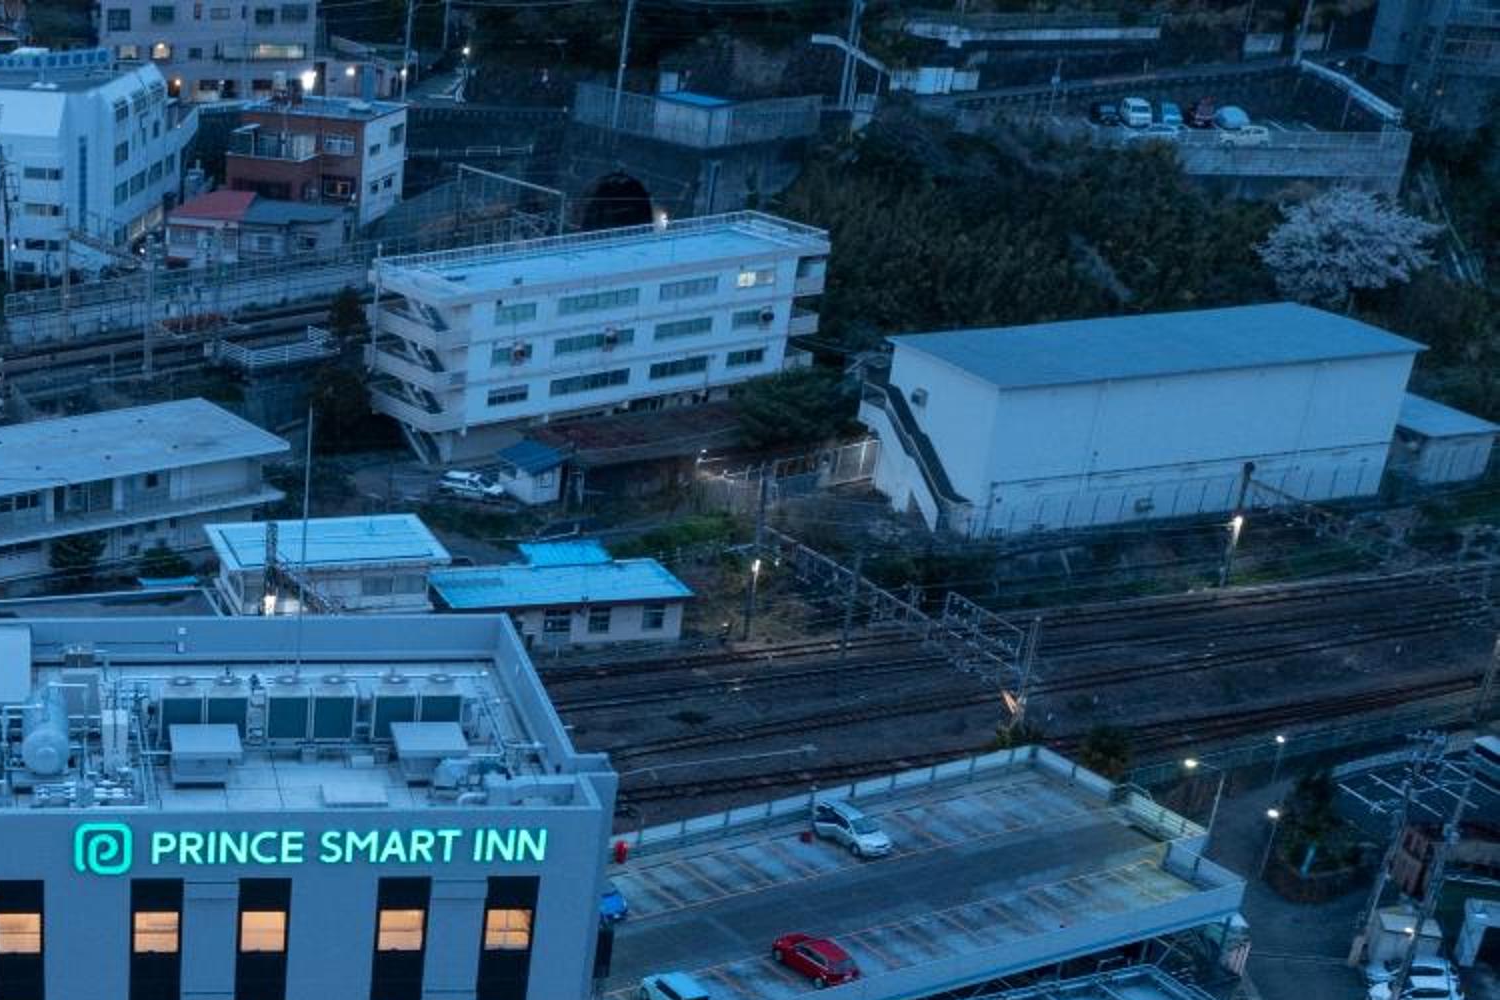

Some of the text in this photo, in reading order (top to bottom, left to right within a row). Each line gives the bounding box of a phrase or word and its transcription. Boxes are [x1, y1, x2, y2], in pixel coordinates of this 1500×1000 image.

[150, 831, 305, 865] PRINCE
[319, 829, 463, 863] SMART
[473, 829, 548, 862] INN
